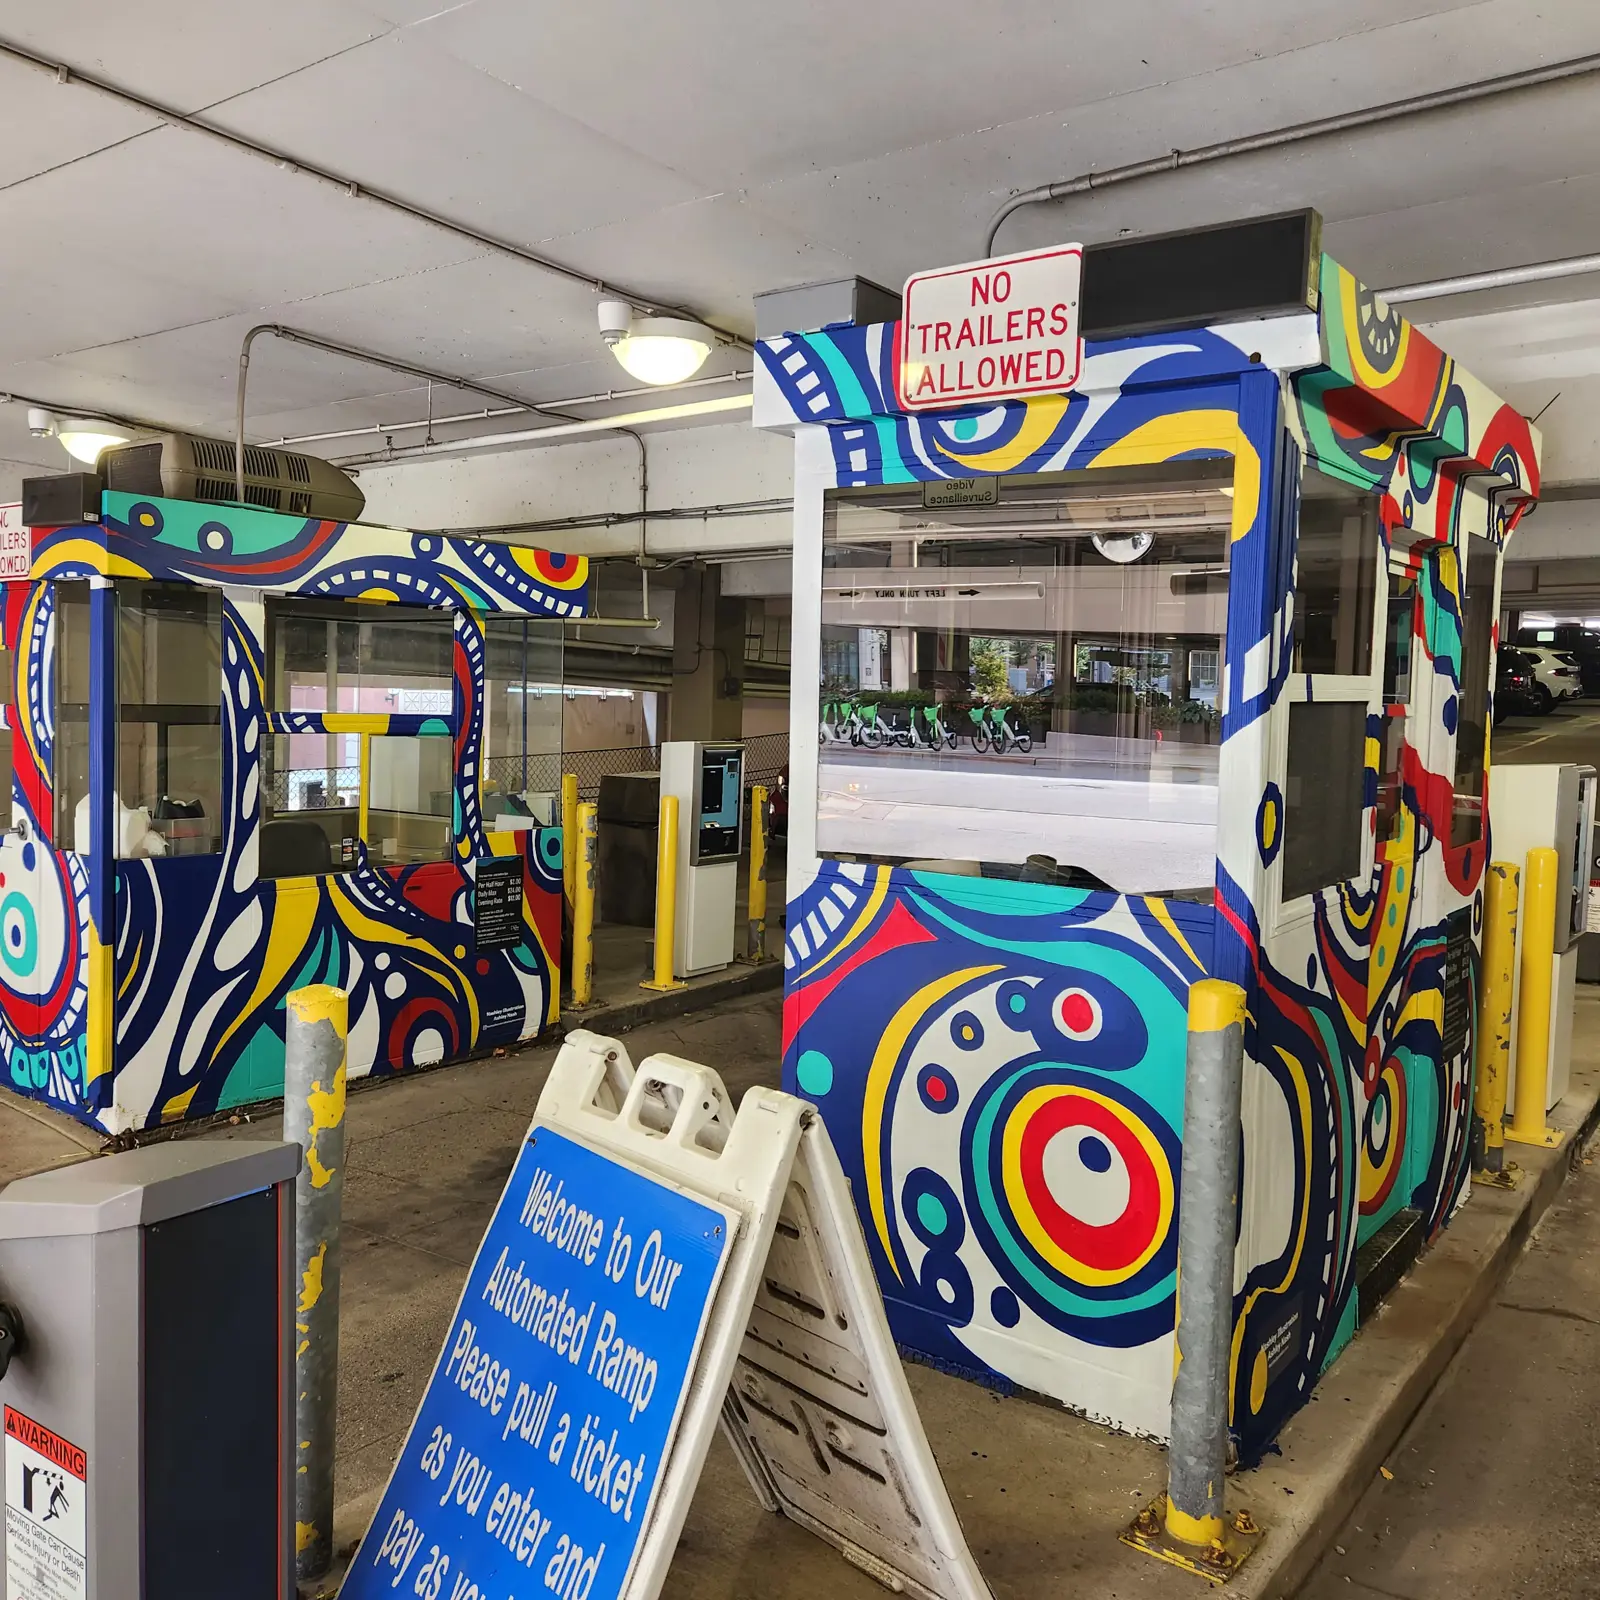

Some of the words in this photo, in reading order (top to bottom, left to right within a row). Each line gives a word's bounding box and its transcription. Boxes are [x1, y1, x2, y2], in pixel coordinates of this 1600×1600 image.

[971, 271, 1011, 307] NO
[917, 303, 1068, 354] TRAILERS
[916, 348, 1065, 396] ALLOWED
[477, 899, 494, 907] Evening
[518, 1167, 605, 1266] Welcome
[604, 1216, 632, 1283] to
[635, 1229, 684, 1311] Our
[481, 1245, 596, 1366] Automated
[587, 1310, 659, 1423] Ramp
[18, 1416, 84, 1476] WARNING
[444, 1319, 511, 1416] Please
[502, 1381, 558, 1450] pull
[548, 1412, 570, 1466] a
[570, 1414, 645, 1523] ticket
[6, 1508, 30, 1534] Moving
[31, 1525, 47, 1543] Gate
[48, 1536, 61, 1553] Can
[62, 1547, 84, 1570] Cause
[420, 1424, 452, 1481] as
[439, 1446, 493, 1517] you
[485, 1482, 552, 1568] enter
[544, 1533, 606, 1600] and
[6, 1522, 31, 1548] Serious
[32, 1540, 51, 1563] Injury
[52, 1556, 60, 1567] or
[61, 1561, 81, 1583] Death
[373, 1507, 425, 1589] pay
[414, 1544, 450, 1600] as
